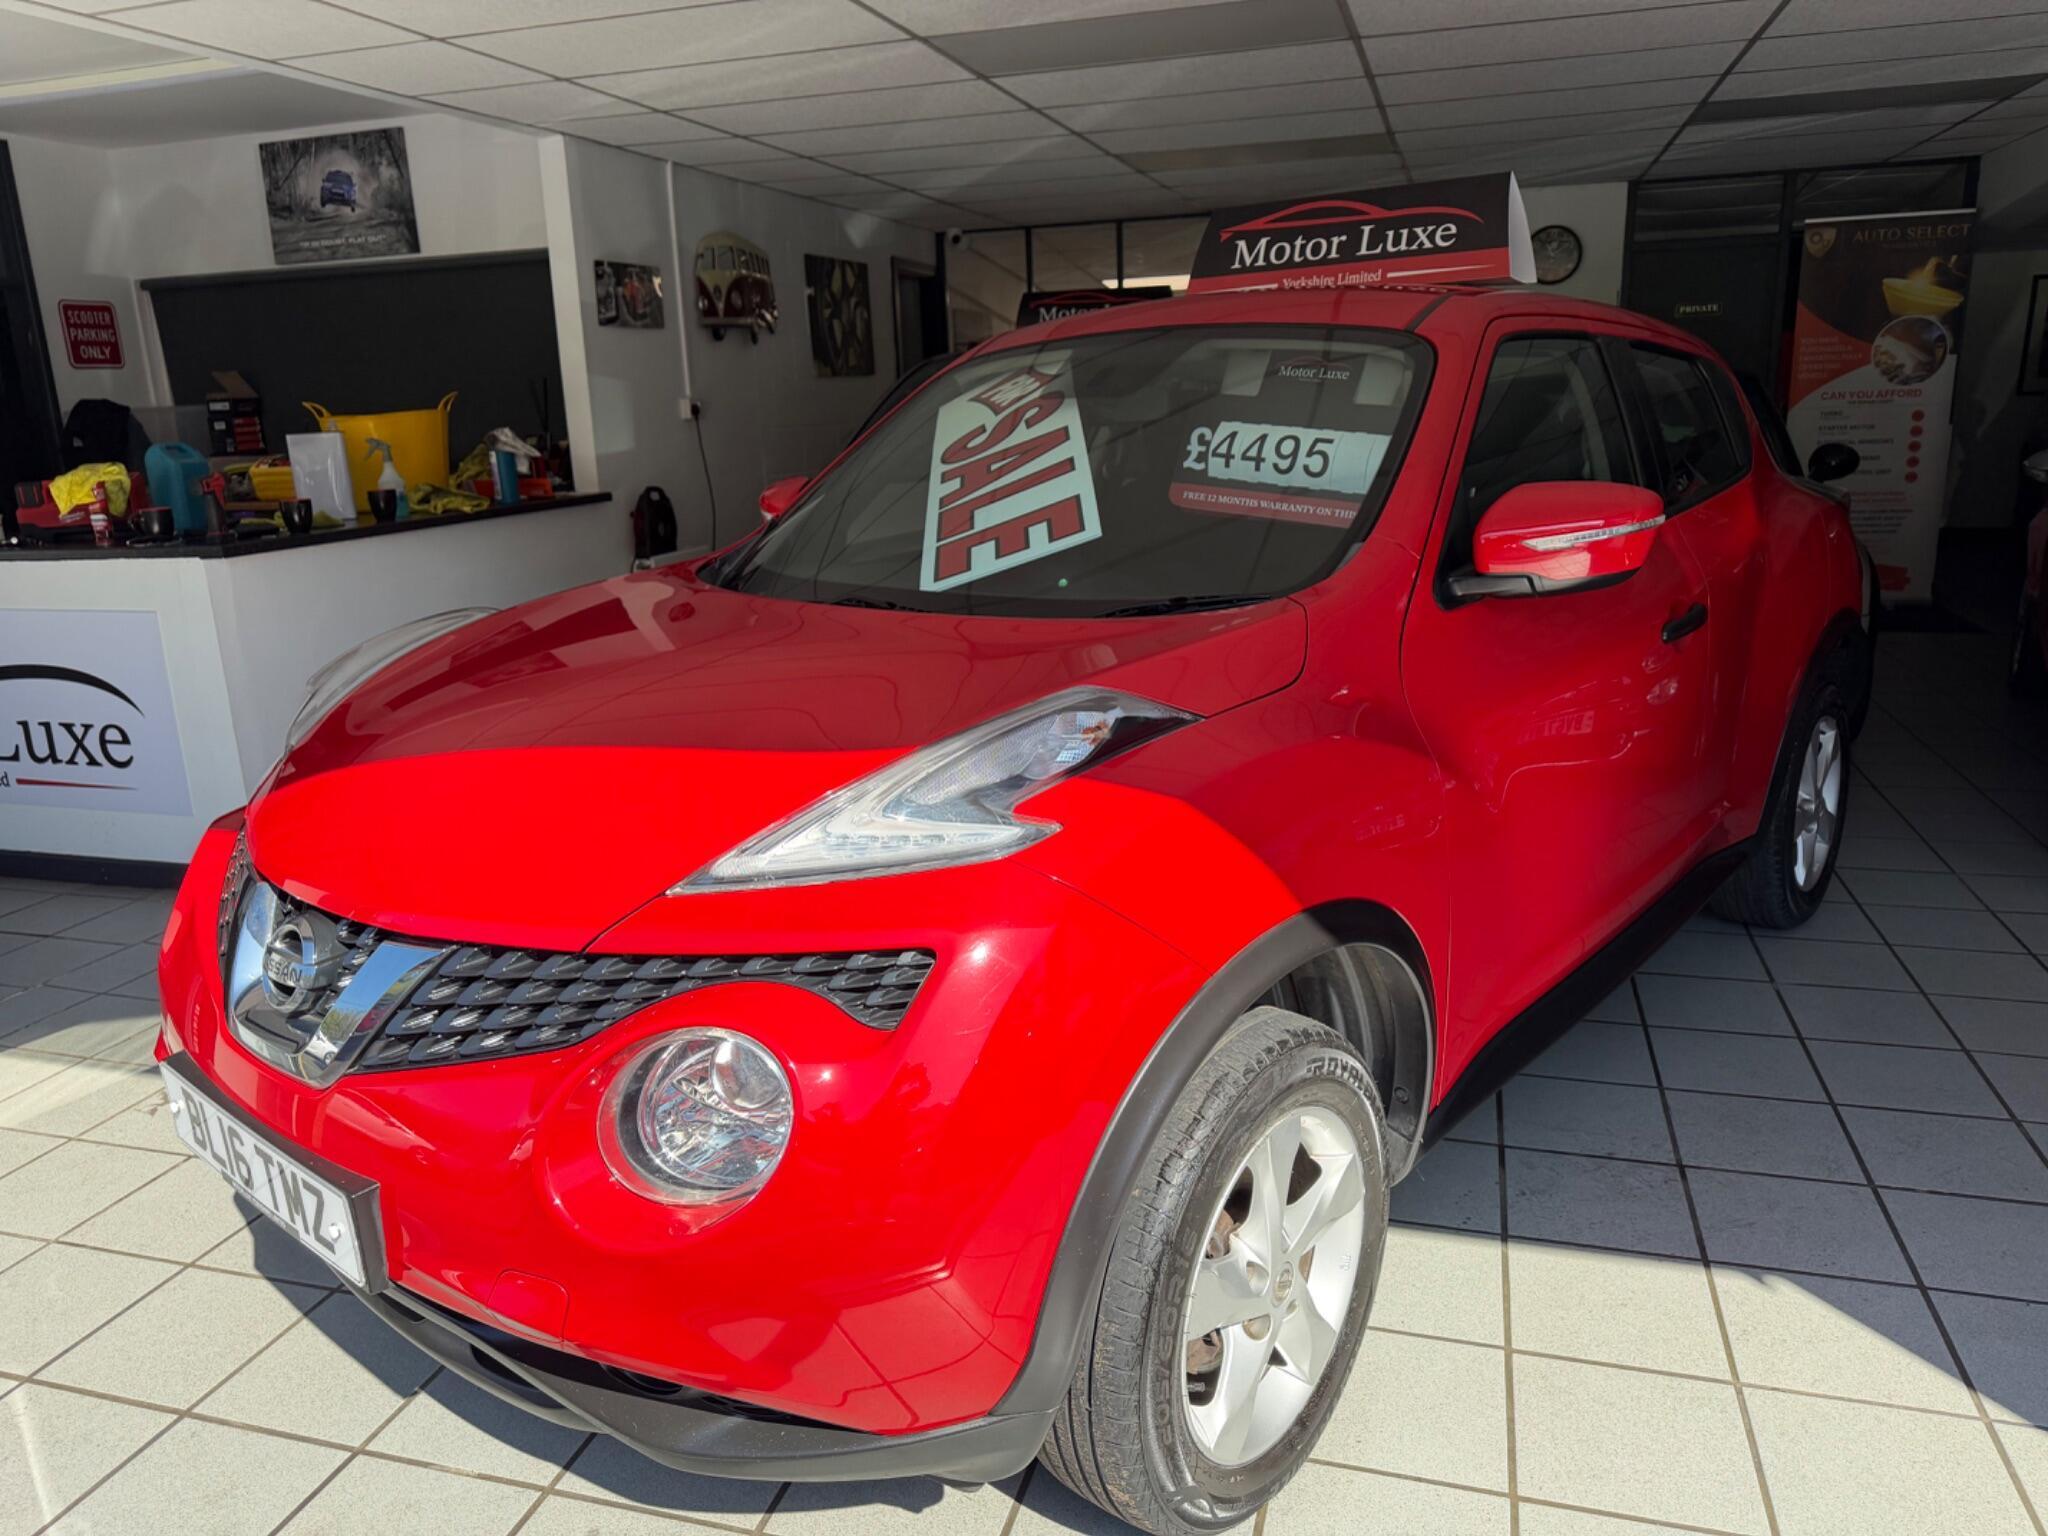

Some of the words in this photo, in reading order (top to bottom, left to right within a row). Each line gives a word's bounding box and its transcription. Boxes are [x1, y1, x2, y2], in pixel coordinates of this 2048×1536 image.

[1854, 228, 1900, 241] AUTO
[1905, 224, 1972, 239] SELECT
[1231, 233, 1347, 269] Motor
[1356, 222, 1458, 256] Luxe
[1283, 274, 1336, 290] Yorkshire
[1338, 269, 1382, 286] Limited
[1040, 305, 1098, 322] Mot
[1679, 303, 1719, 314] PRIVATE
[67, 309, 113, 326] SCOOTER
[69, 327, 116, 343] PARKING
[80, 344, 111, 360] ONLY
[1278, 365, 1318, 378] Motor
[1318, 367, 1351, 380] Luxe
[1821, 391, 1846, 401] CAN
[1848, 390, 1874, 400] YOU
[1875, 388, 1922, 399] AFFORD
[1183, 426, 1335, 478] £4495
[933, 390, 1086, 584] SALE
[1183, 491, 1206, 500] FREE
[1207, 494, 1217, 502] 12
[1217, 495, 1258, 507] MONTHS
[1259, 499, 1315, 514] WARRANTY
[1316, 507, 1332, 515] ON
[181, 1086, 254, 1191] BL16
[254, 1144, 336, 1255] TMZ
